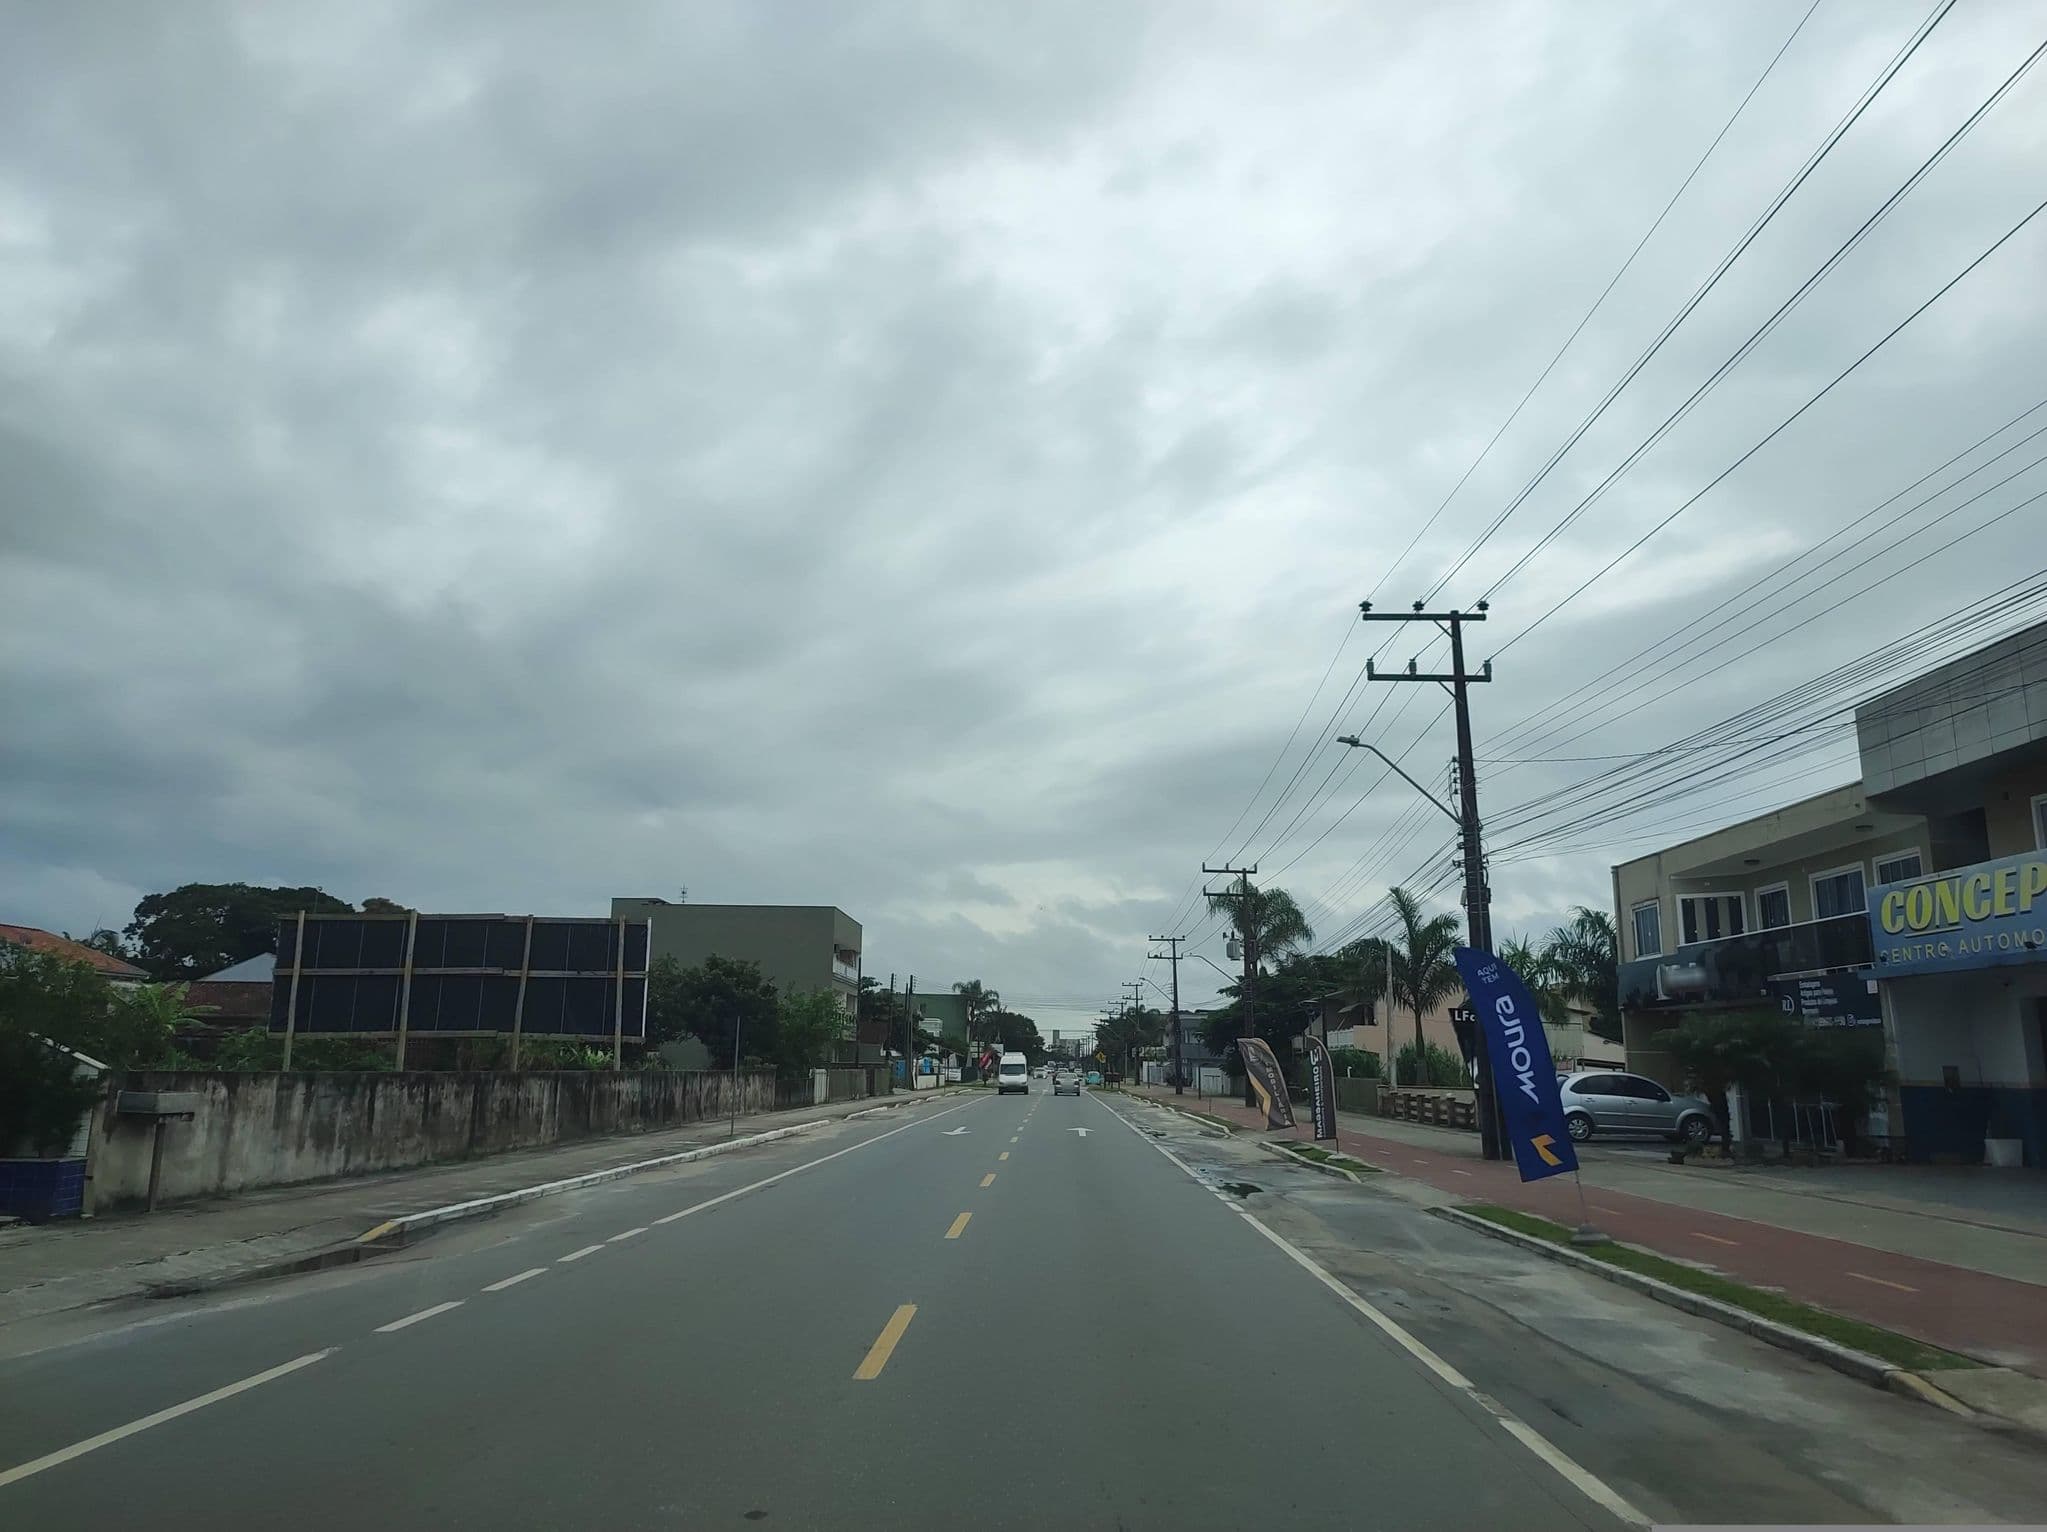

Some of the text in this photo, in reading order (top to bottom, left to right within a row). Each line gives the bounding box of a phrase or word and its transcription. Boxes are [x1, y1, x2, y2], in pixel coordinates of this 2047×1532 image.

[1881, 862, 2047, 934] CONCEP
[1477, 963, 1497, 976] AQUI
[1481, 972, 1499, 984] TEM
